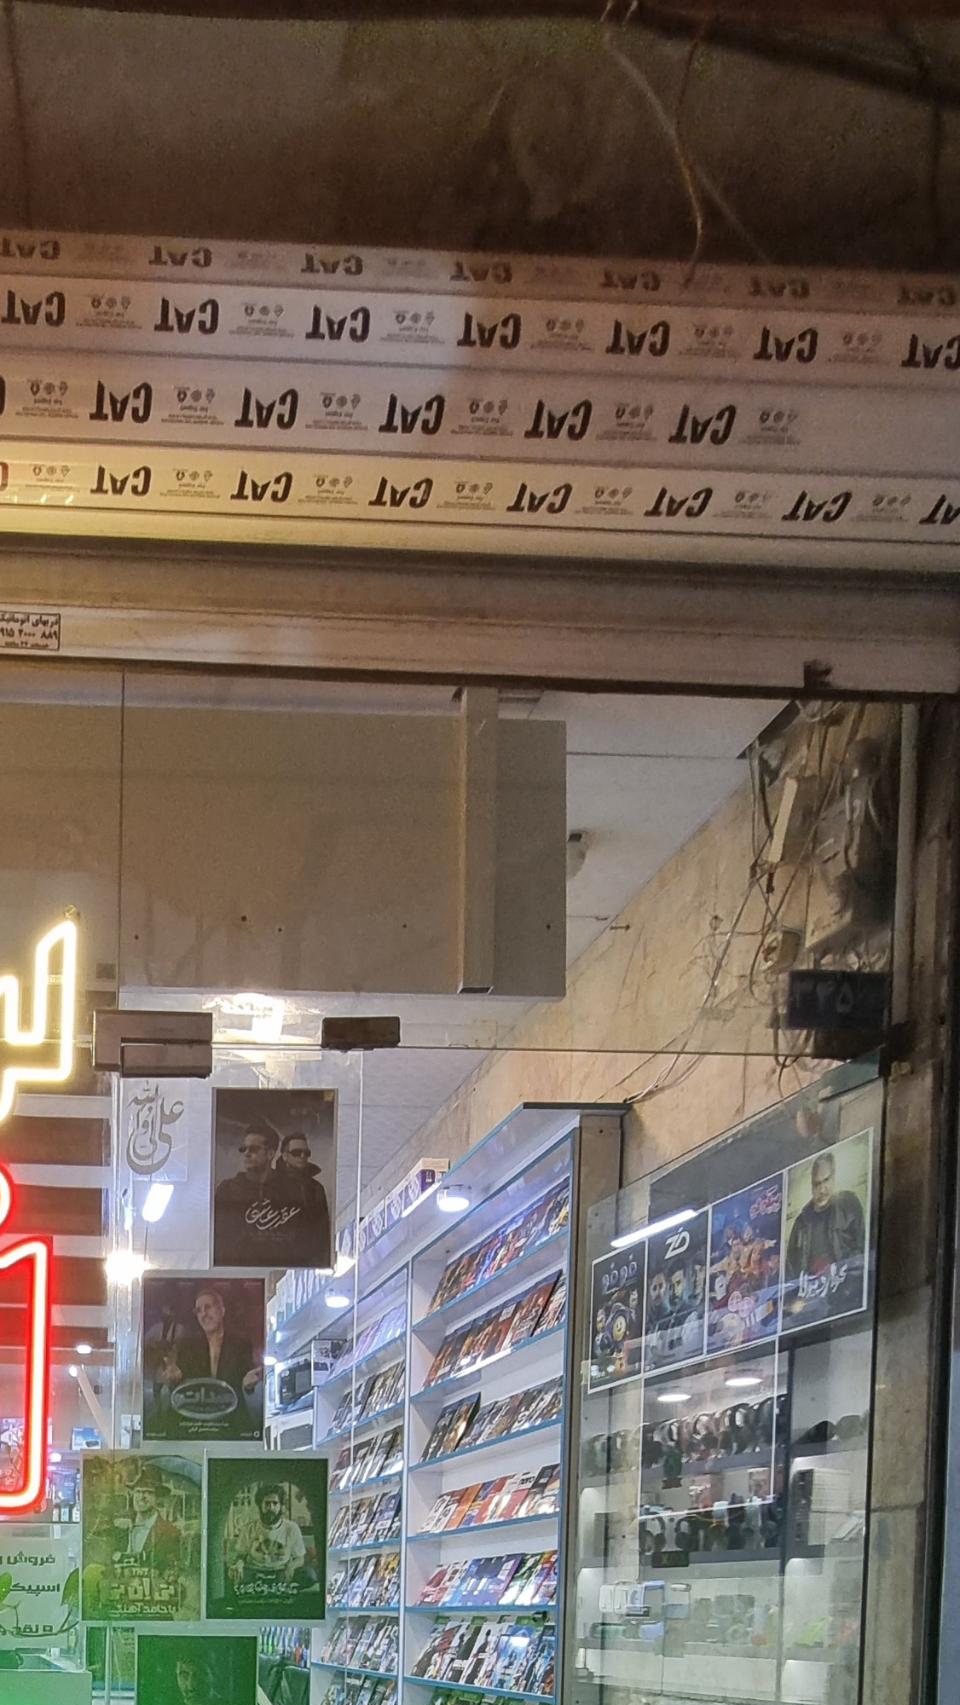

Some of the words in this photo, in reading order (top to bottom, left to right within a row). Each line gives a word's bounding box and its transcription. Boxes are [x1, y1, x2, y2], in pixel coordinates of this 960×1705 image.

[1, 290, 65, 327] CAT
[154, 297, 219, 334] CAT
[305, 305, 370, 342] CAT
[457, 312, 521, 350] CAT
[605, 320, 670, 357] CAT
[753, 326, 818, 364] CAT
[901, 334, 960, 371] CAT
[89, 381, 152, 423] CAT
[234, 388, 298, 430] CAT
[379, 394, 445, 435] CAT
[524, 399, 592, 441] CAT
[668, 404, 736, 445] CAT
[90, 466, 151, 496] CAT
[230, 471, 292, 502] CAT
[368, 477, 433, 508] CAT
[506, 483, 572, 514] CAT
[644, 487, 713, 518] CAT
[781, 491, 852, 523] CAT
[919, 494, 960, 525] AT
[7, 1551, 56, 1566] فروش
[10, 1582, 61, 1597] اسپیک
